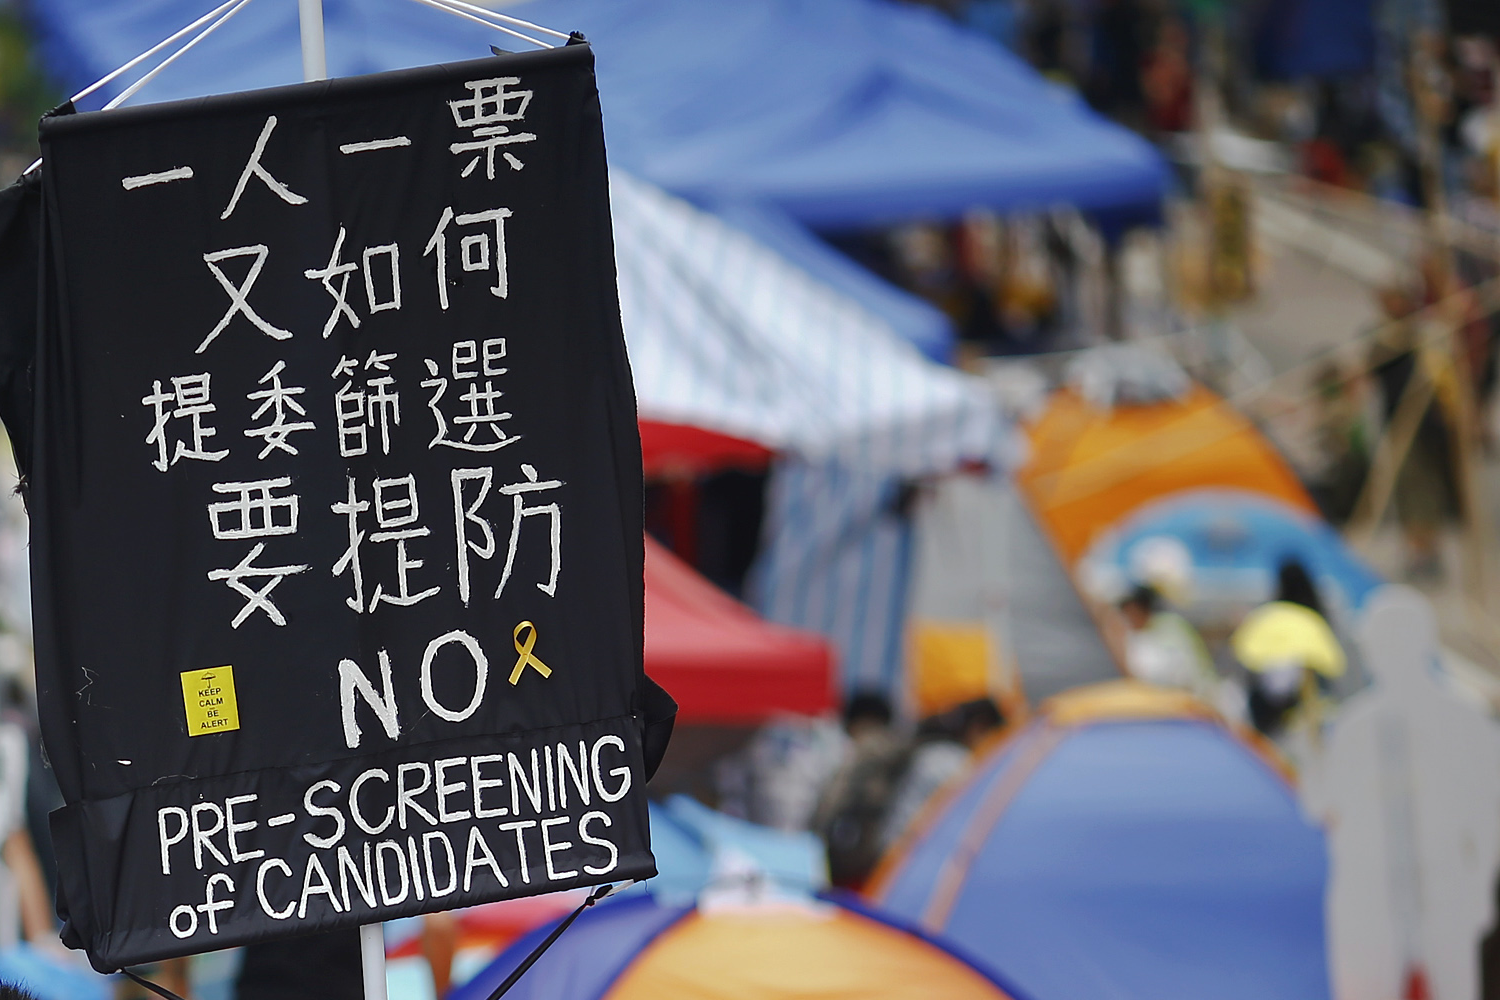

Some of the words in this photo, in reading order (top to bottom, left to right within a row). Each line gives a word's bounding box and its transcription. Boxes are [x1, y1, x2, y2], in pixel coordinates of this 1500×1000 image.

[121, 76, 537, 220] 一人一票
[194, 206, 514, 354] 又如何
[141, 337, 522, 473] 提委篩選
[207, 463, 562, 630] 要提防
[198, 687, 222, 698] KEEP
[198, 697, 224, 708] CALM
[200, 718, 229, 729] ALERT
[206, 709, 219, 718] BE
[337, 629, 489, 749] NO
[157, 734, 632, 875] PRE-SCREENING
[169, 872, 236, 939] of
[256, 810, 618, 920] CANDIDATES
